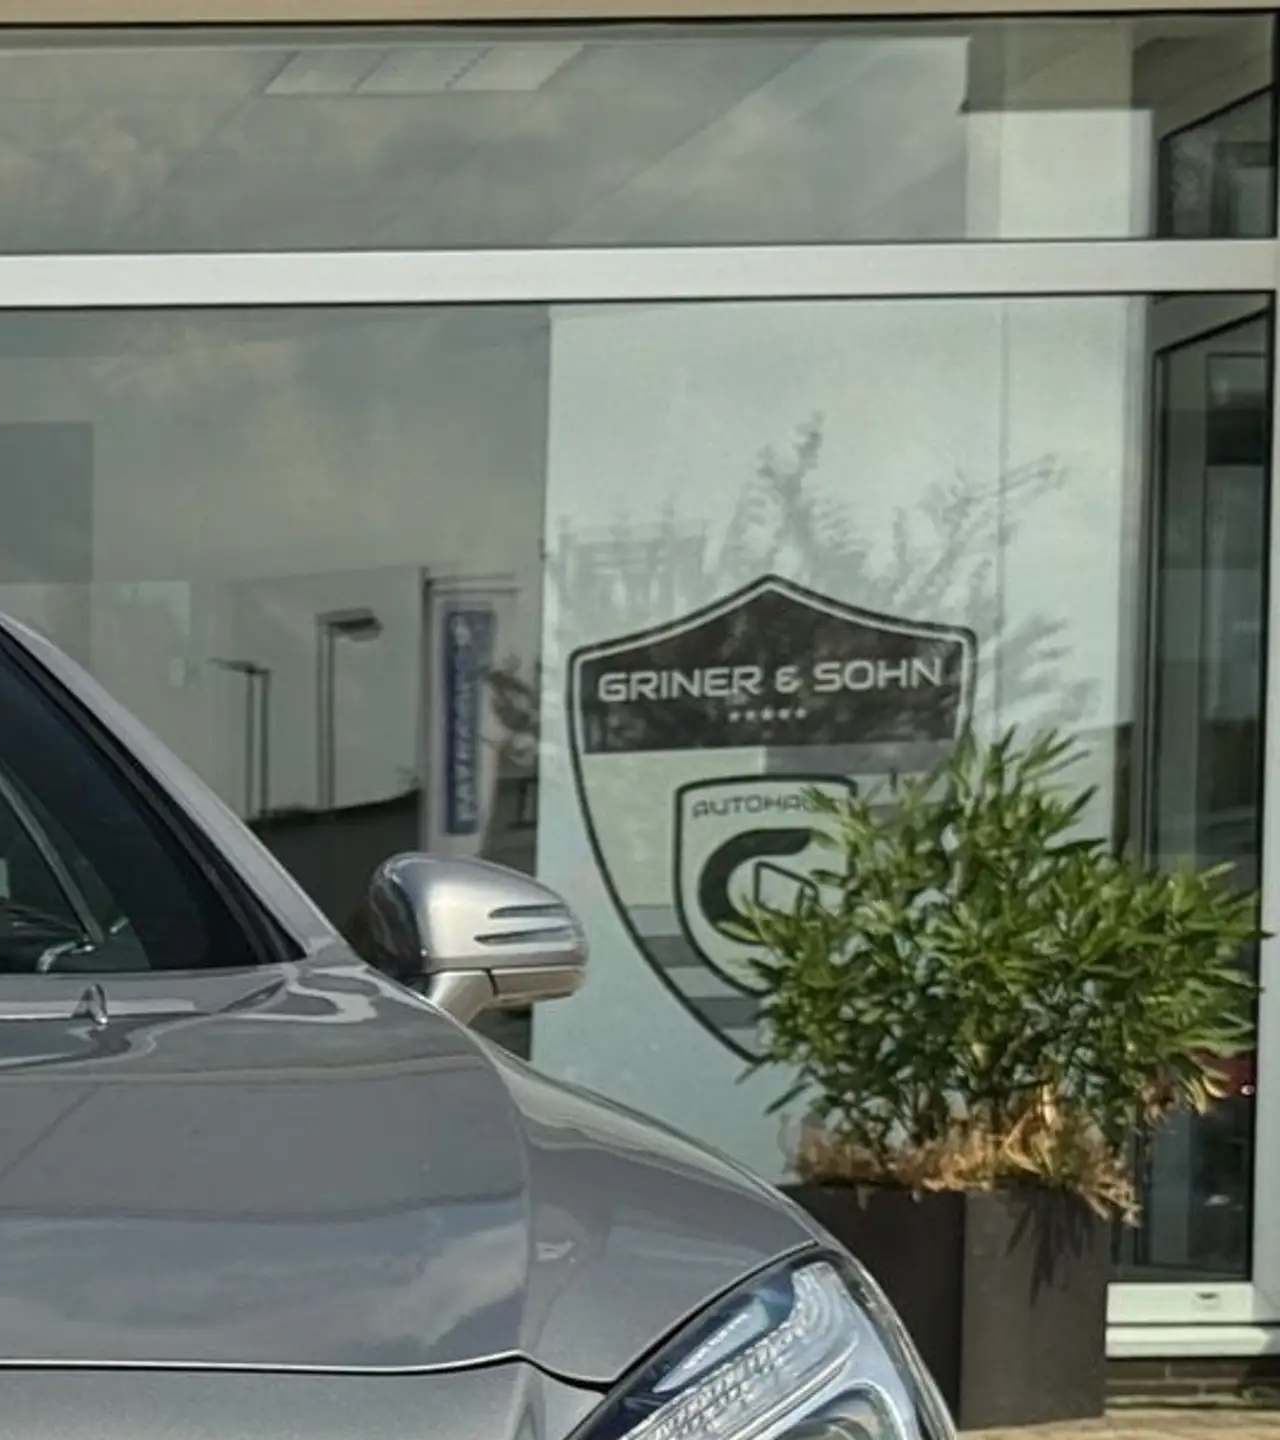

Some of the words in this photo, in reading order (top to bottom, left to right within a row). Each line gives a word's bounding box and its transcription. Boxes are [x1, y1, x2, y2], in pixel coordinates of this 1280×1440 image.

[597, 665, 763, 703] GRINER
[774, 664, 804, 694] &
[812, 654, 945, 692] SOHN
